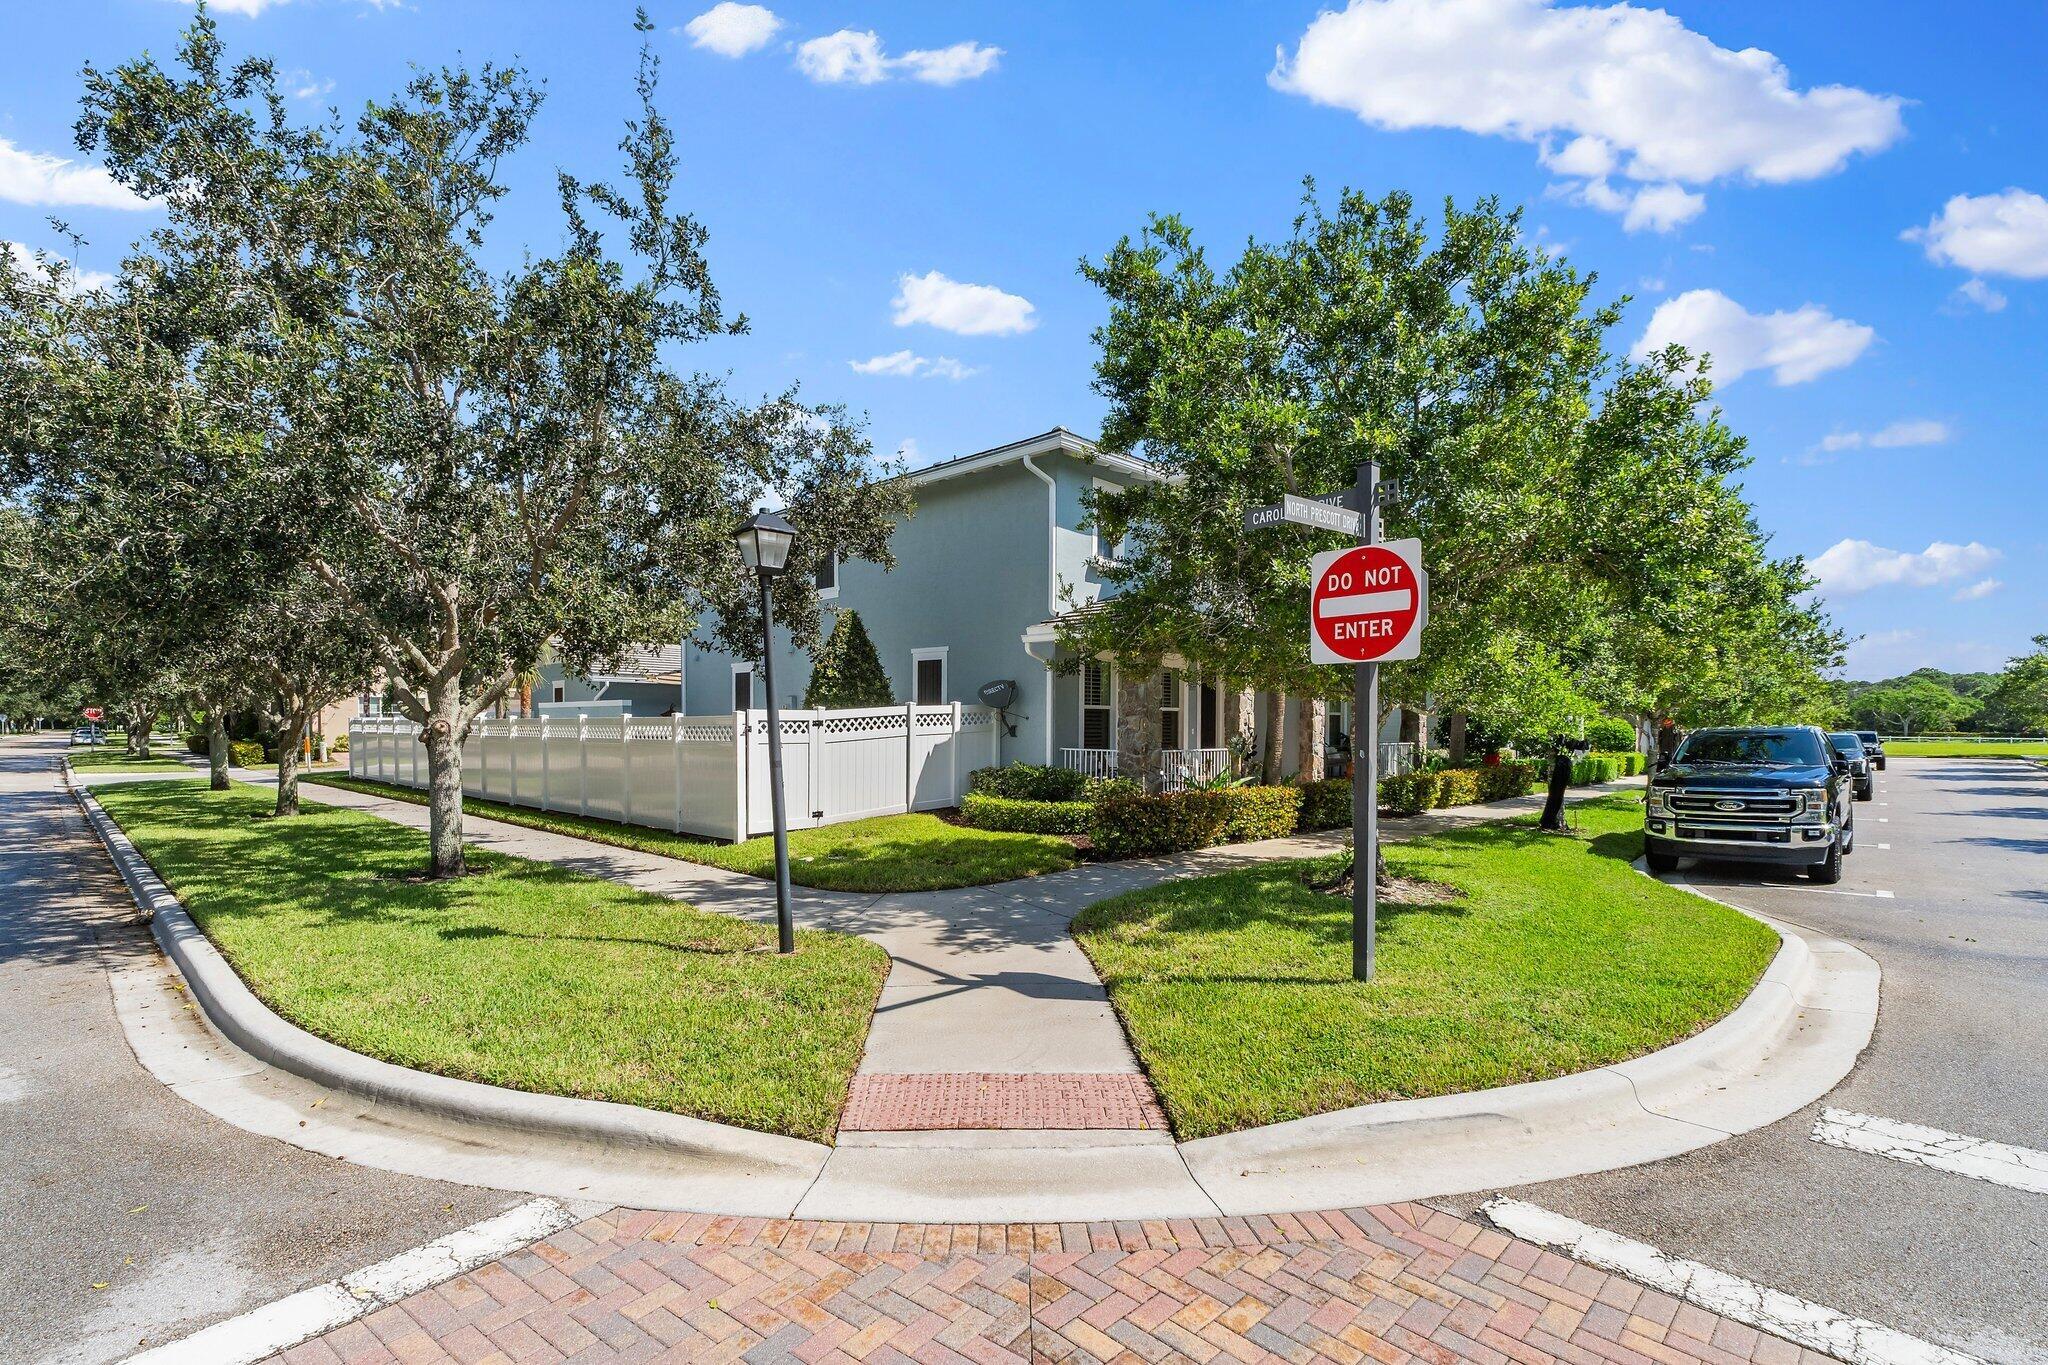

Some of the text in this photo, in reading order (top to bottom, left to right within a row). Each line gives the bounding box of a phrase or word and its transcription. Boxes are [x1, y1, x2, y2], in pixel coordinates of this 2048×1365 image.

[1252, 495, 1344, 525] CAROL IVE
[1286, 500, 1360, 533] NORTH PRESCOTT DRIVE
[1328, 565, 1402, 592] DO NOT
[1334, 618, 1394, 640] ENTER
